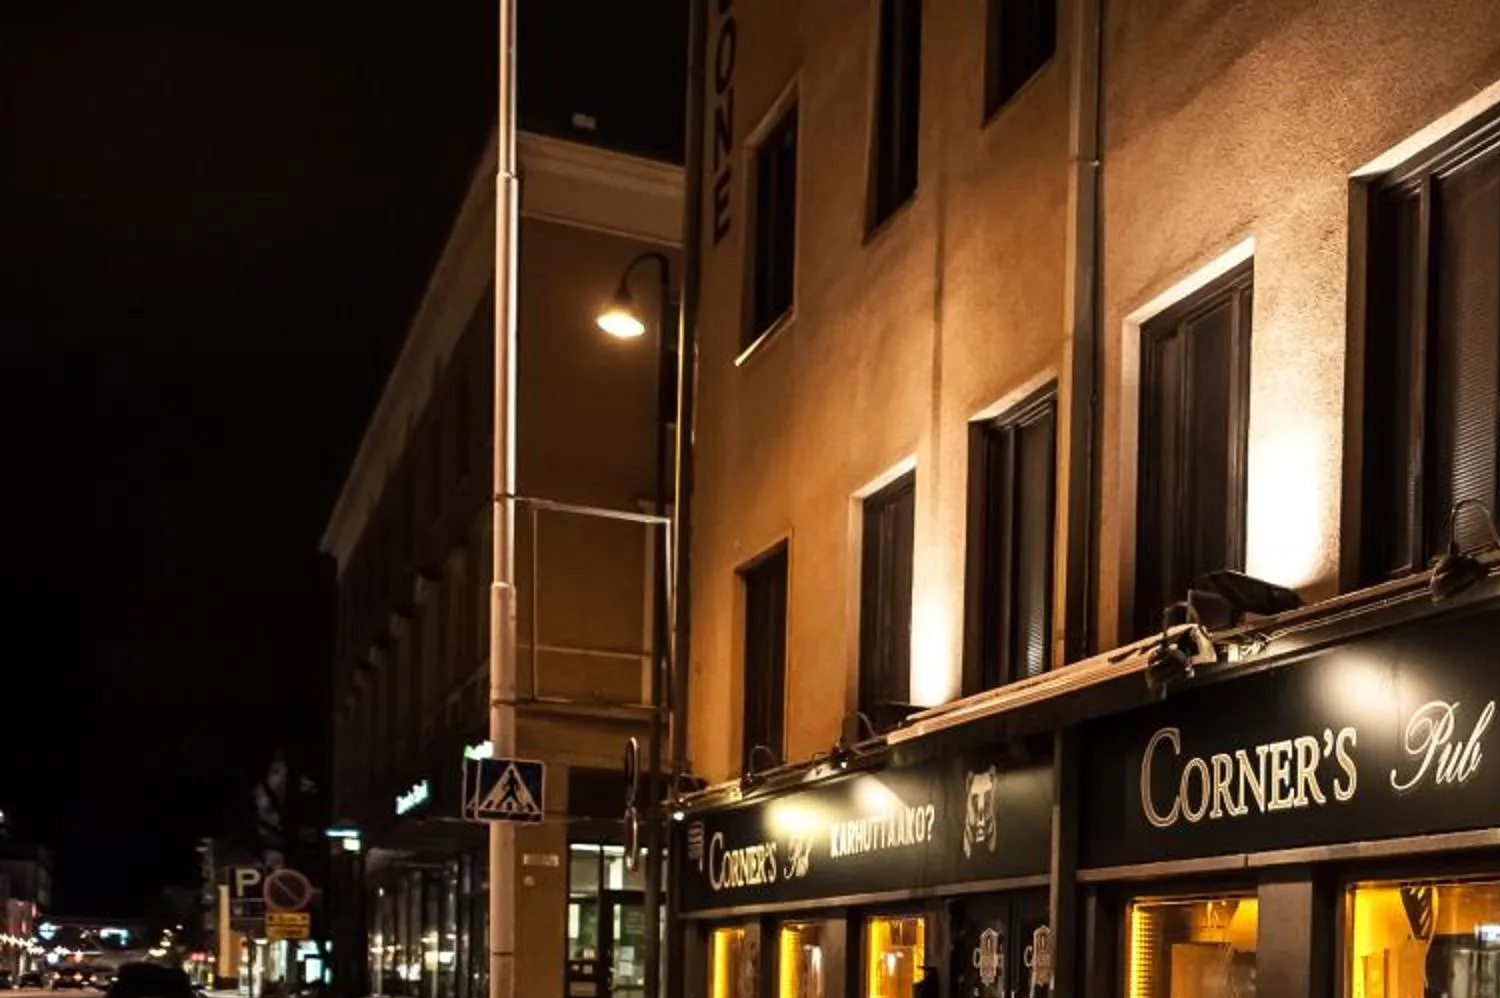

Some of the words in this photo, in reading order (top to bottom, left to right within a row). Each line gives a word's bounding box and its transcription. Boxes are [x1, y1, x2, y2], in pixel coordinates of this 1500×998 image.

[713, 0, 737, 246] ONE
[1140, 726, 1358, 828] CORNER'S
[1391, 700, 1496, 791] Pub
[235, 868, 261, 897] P
[709, 832, 778, 891] CORNER'S
